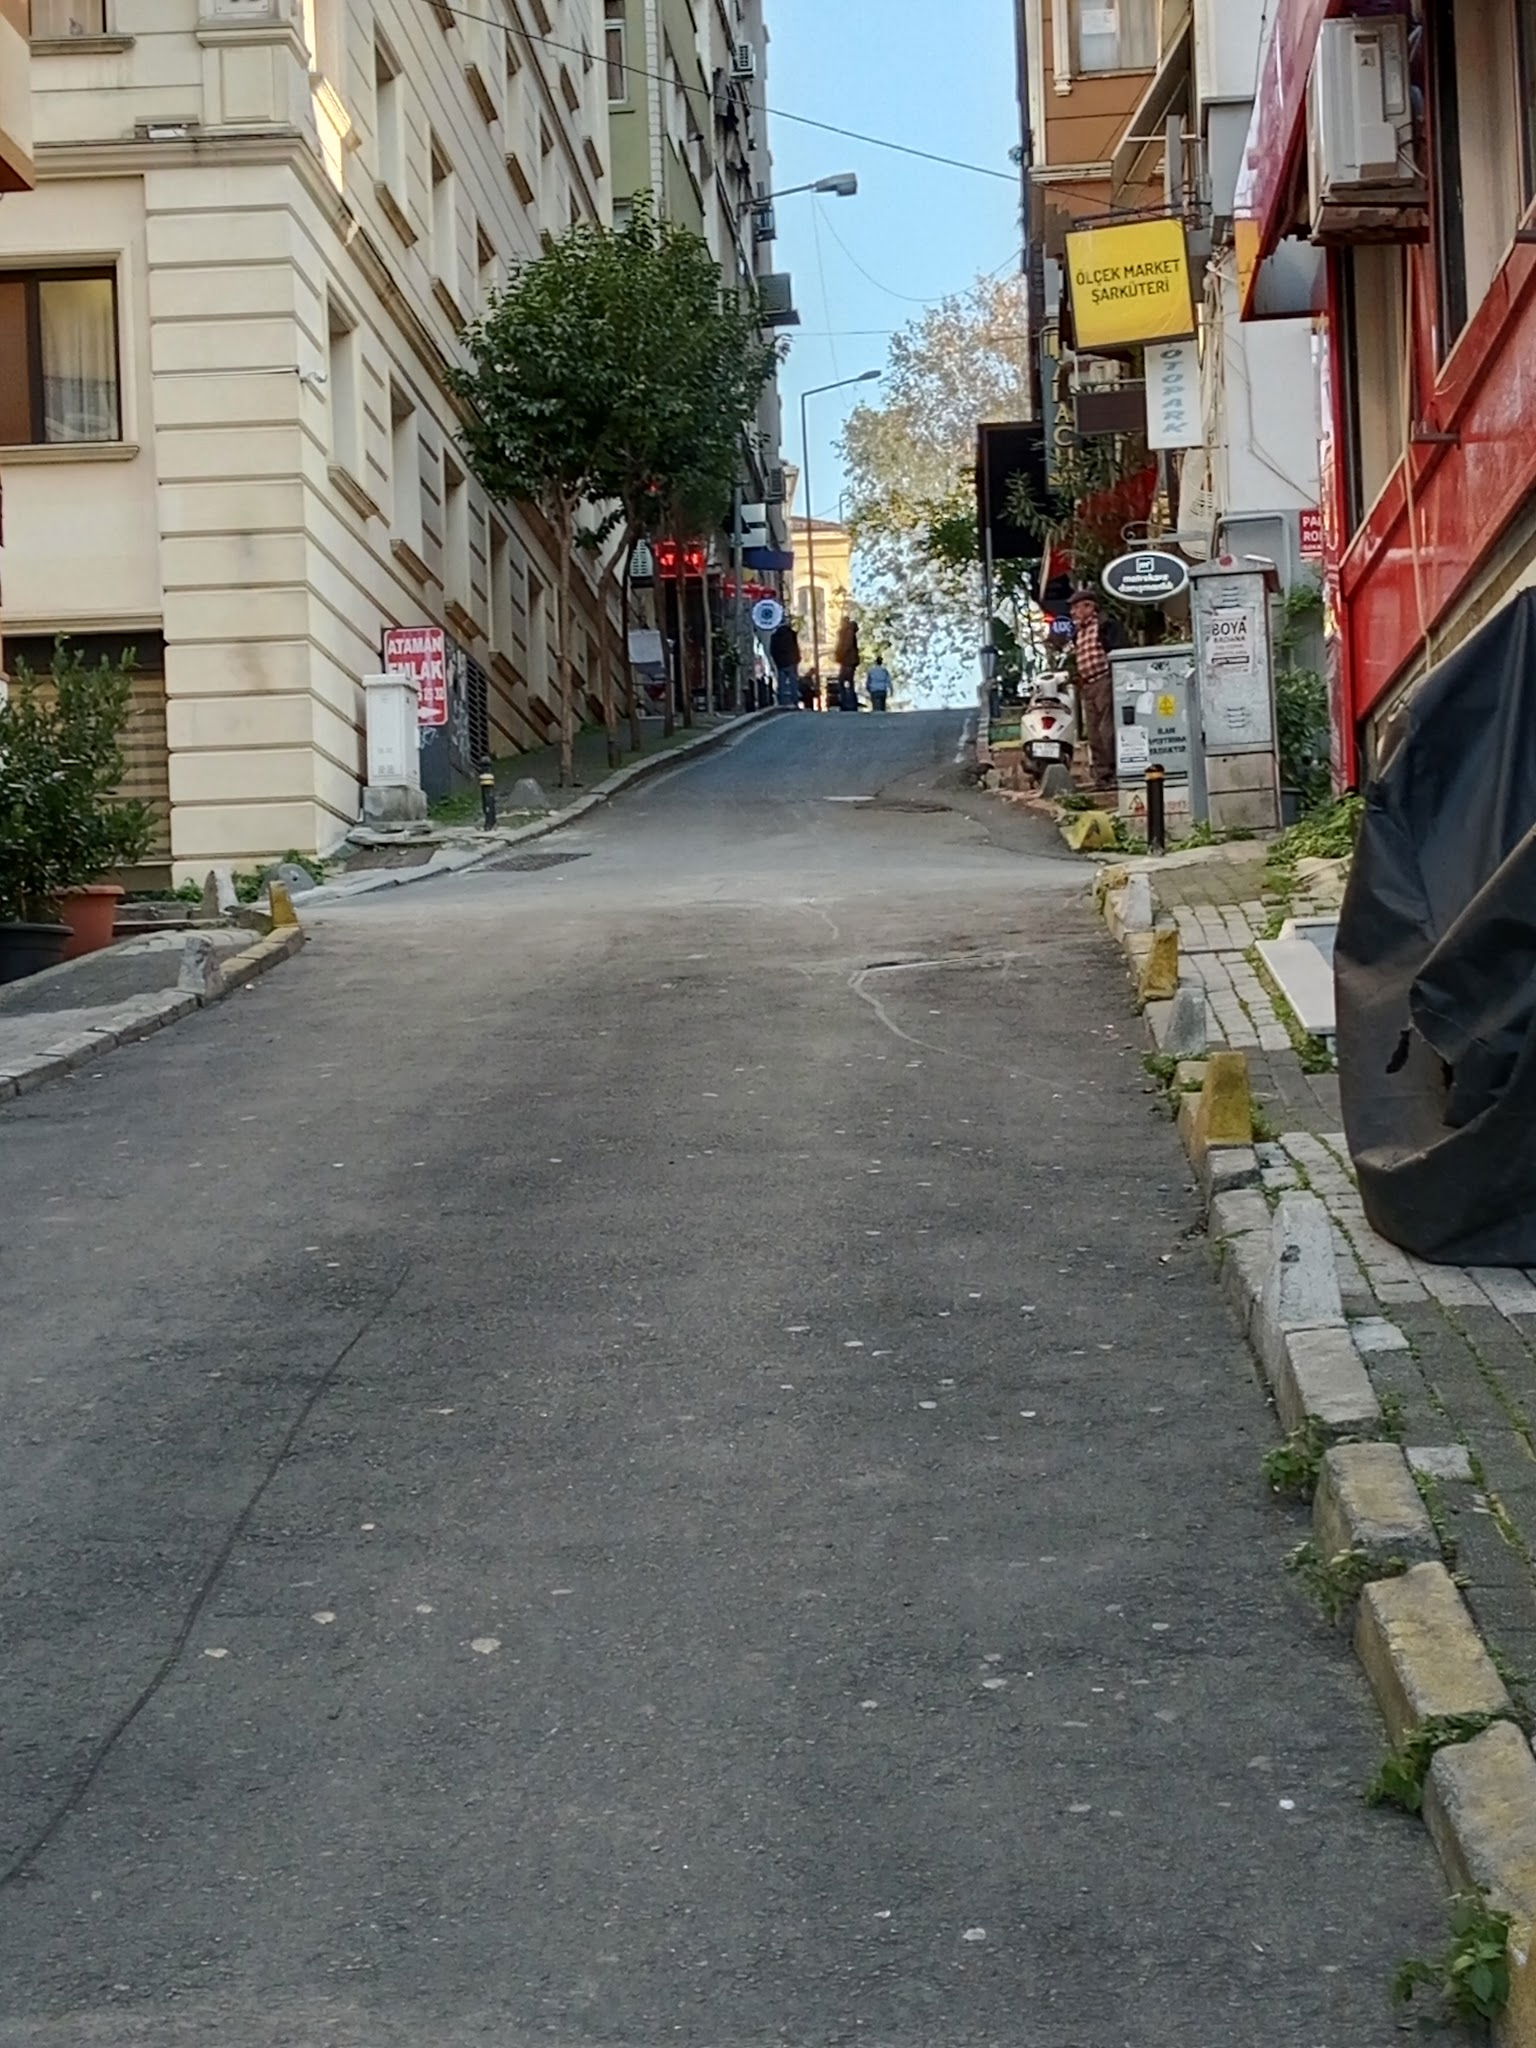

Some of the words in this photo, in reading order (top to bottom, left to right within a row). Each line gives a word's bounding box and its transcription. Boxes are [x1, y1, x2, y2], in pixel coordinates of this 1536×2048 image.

[1075, 266, 1121, 287] ÖLÇEK
[1124, 258, 1181, 279] MARKET
[1091, 276, 1170, 306] ŞARKÜTERİ
[1211, 620, 1247, 636] BOYA
[387, 636, 442, 656] ATAMAN
[387, 660, 443, 680] EMLAK
